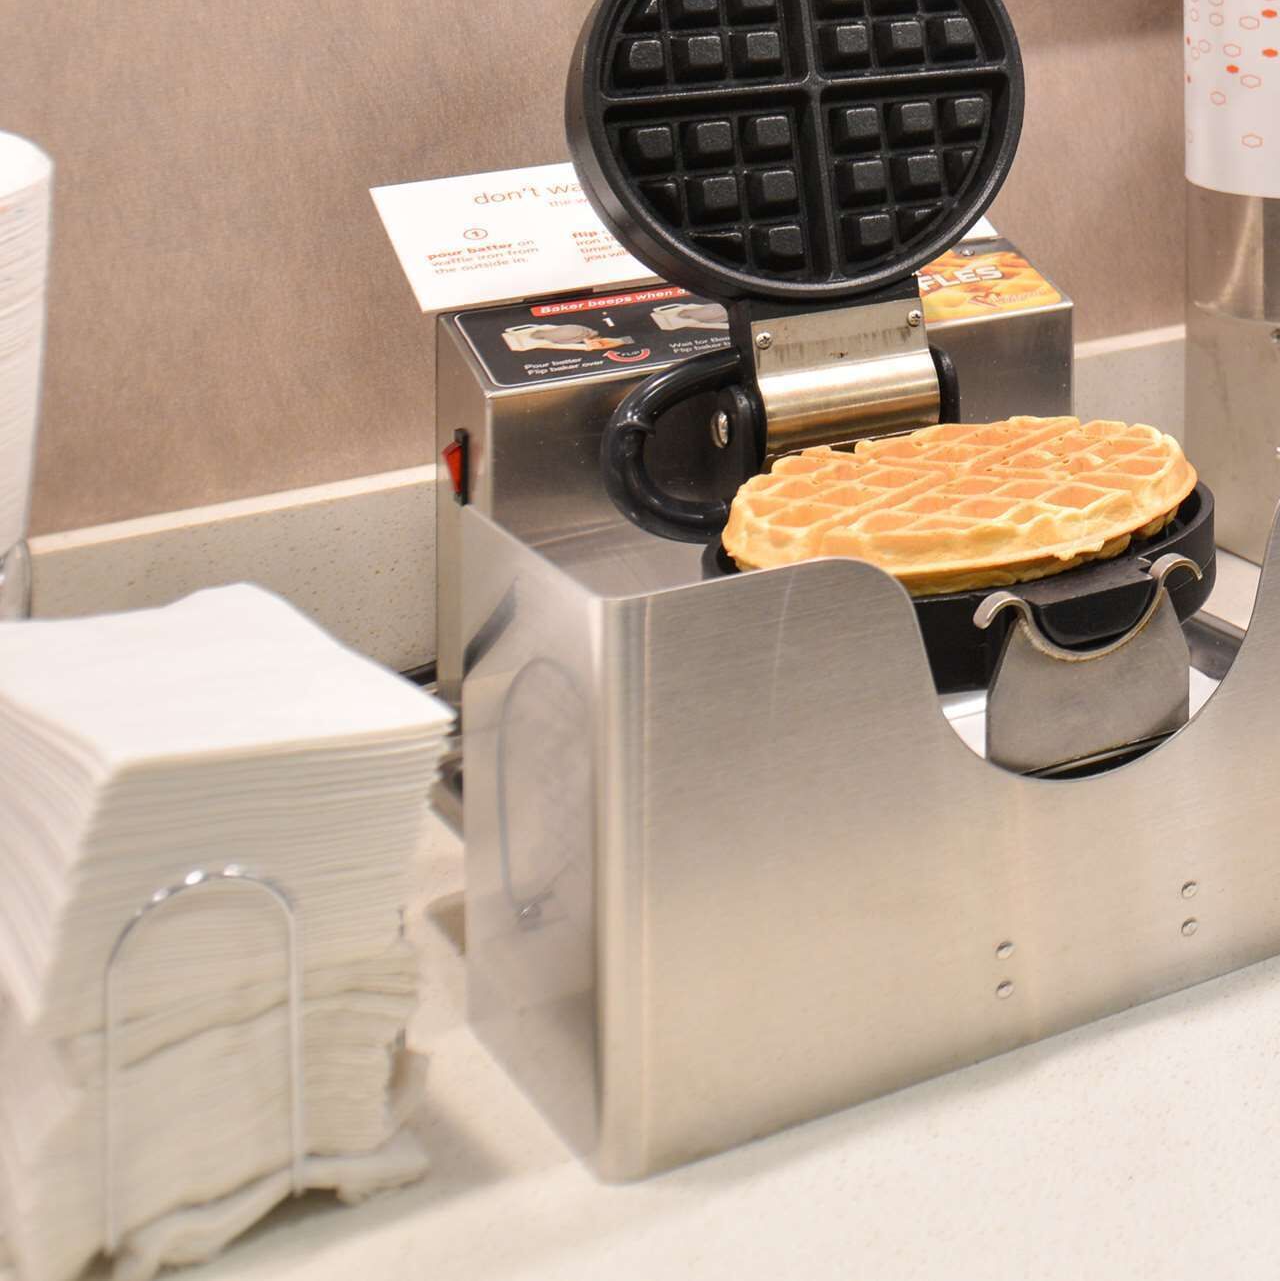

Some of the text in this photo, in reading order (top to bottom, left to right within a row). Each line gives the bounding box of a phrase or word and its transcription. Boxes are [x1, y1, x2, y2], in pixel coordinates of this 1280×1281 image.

[473, 185, 541, 205] don't
[426, 239, 535, 261] pour batter on
[540, 302, 584, 314] Baker
[588, 296, 632, 308] beeps
[635, 289, 673, 301] when
[524, 357, 583, 370] Pour batter
[527, 360, 604, 376] Flip baker over
